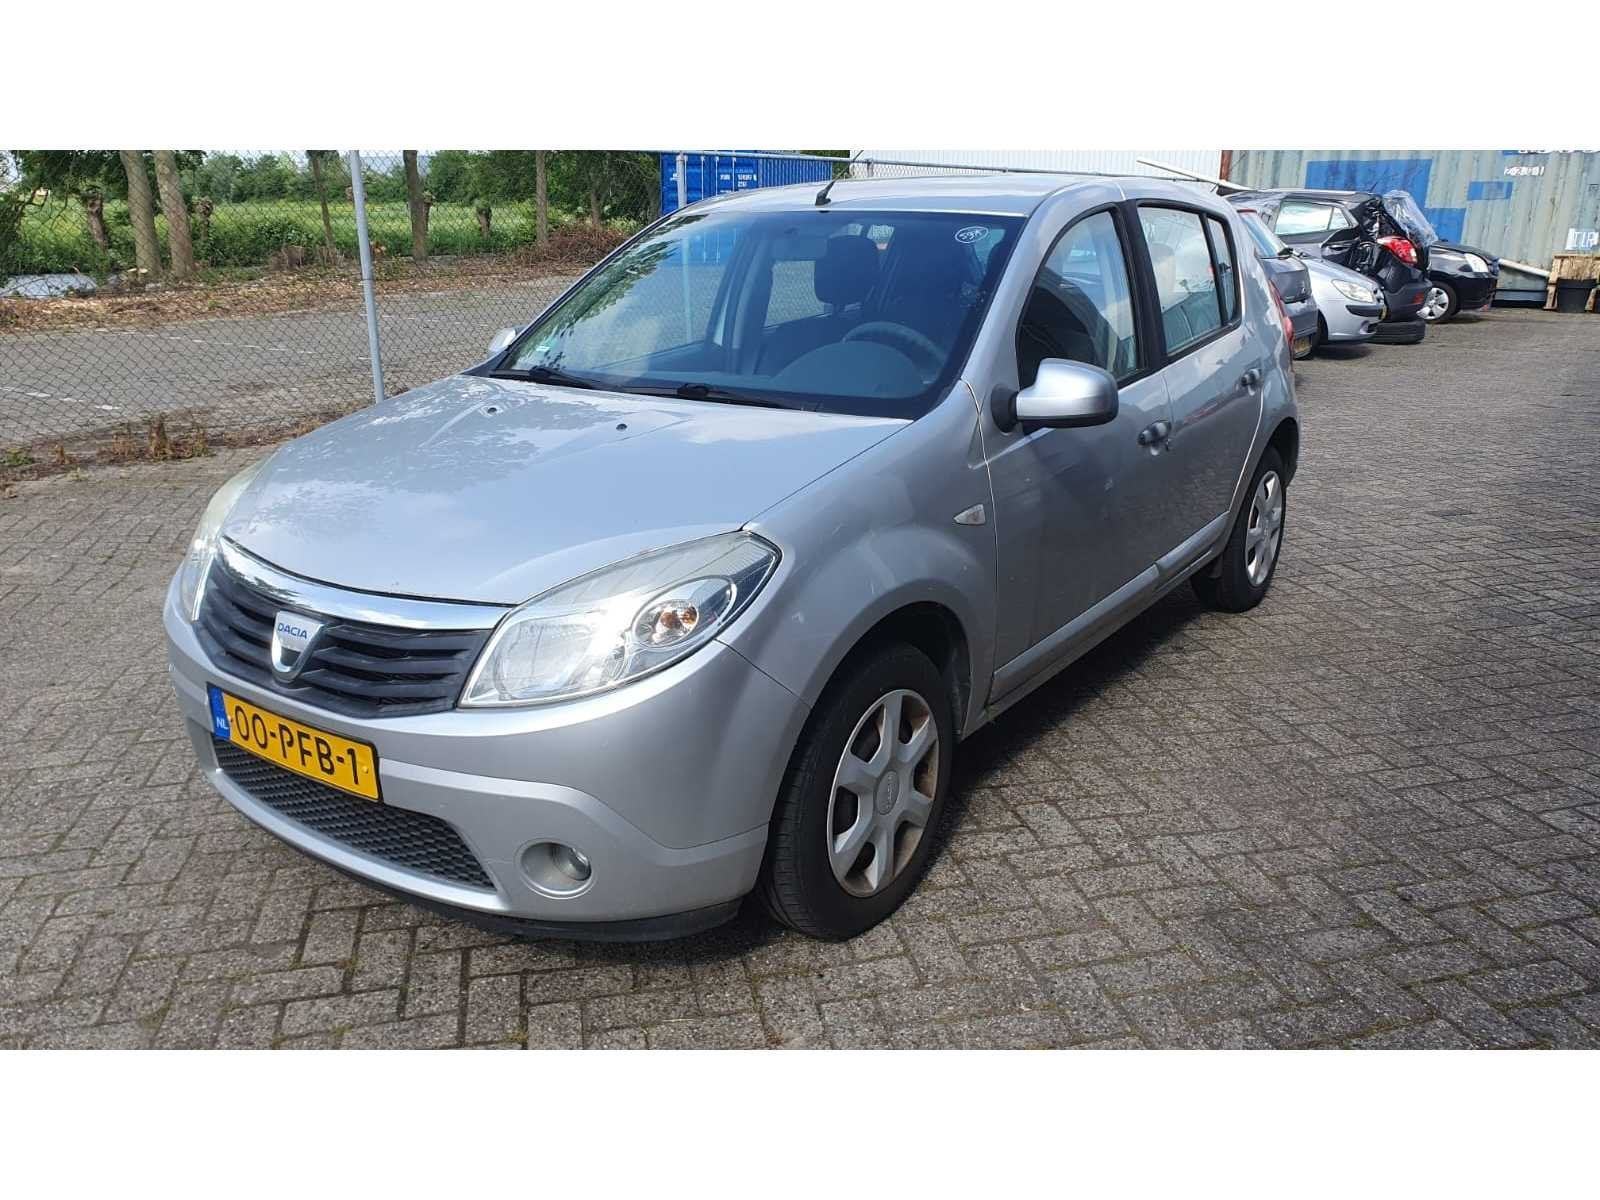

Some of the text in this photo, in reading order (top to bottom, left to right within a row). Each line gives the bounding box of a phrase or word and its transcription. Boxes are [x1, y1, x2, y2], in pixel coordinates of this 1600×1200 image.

[277, 622, 308, 639] DACIA
[216, 717, 229, 729] NL
[234, 705, 359, 785] 00-PFB-1
